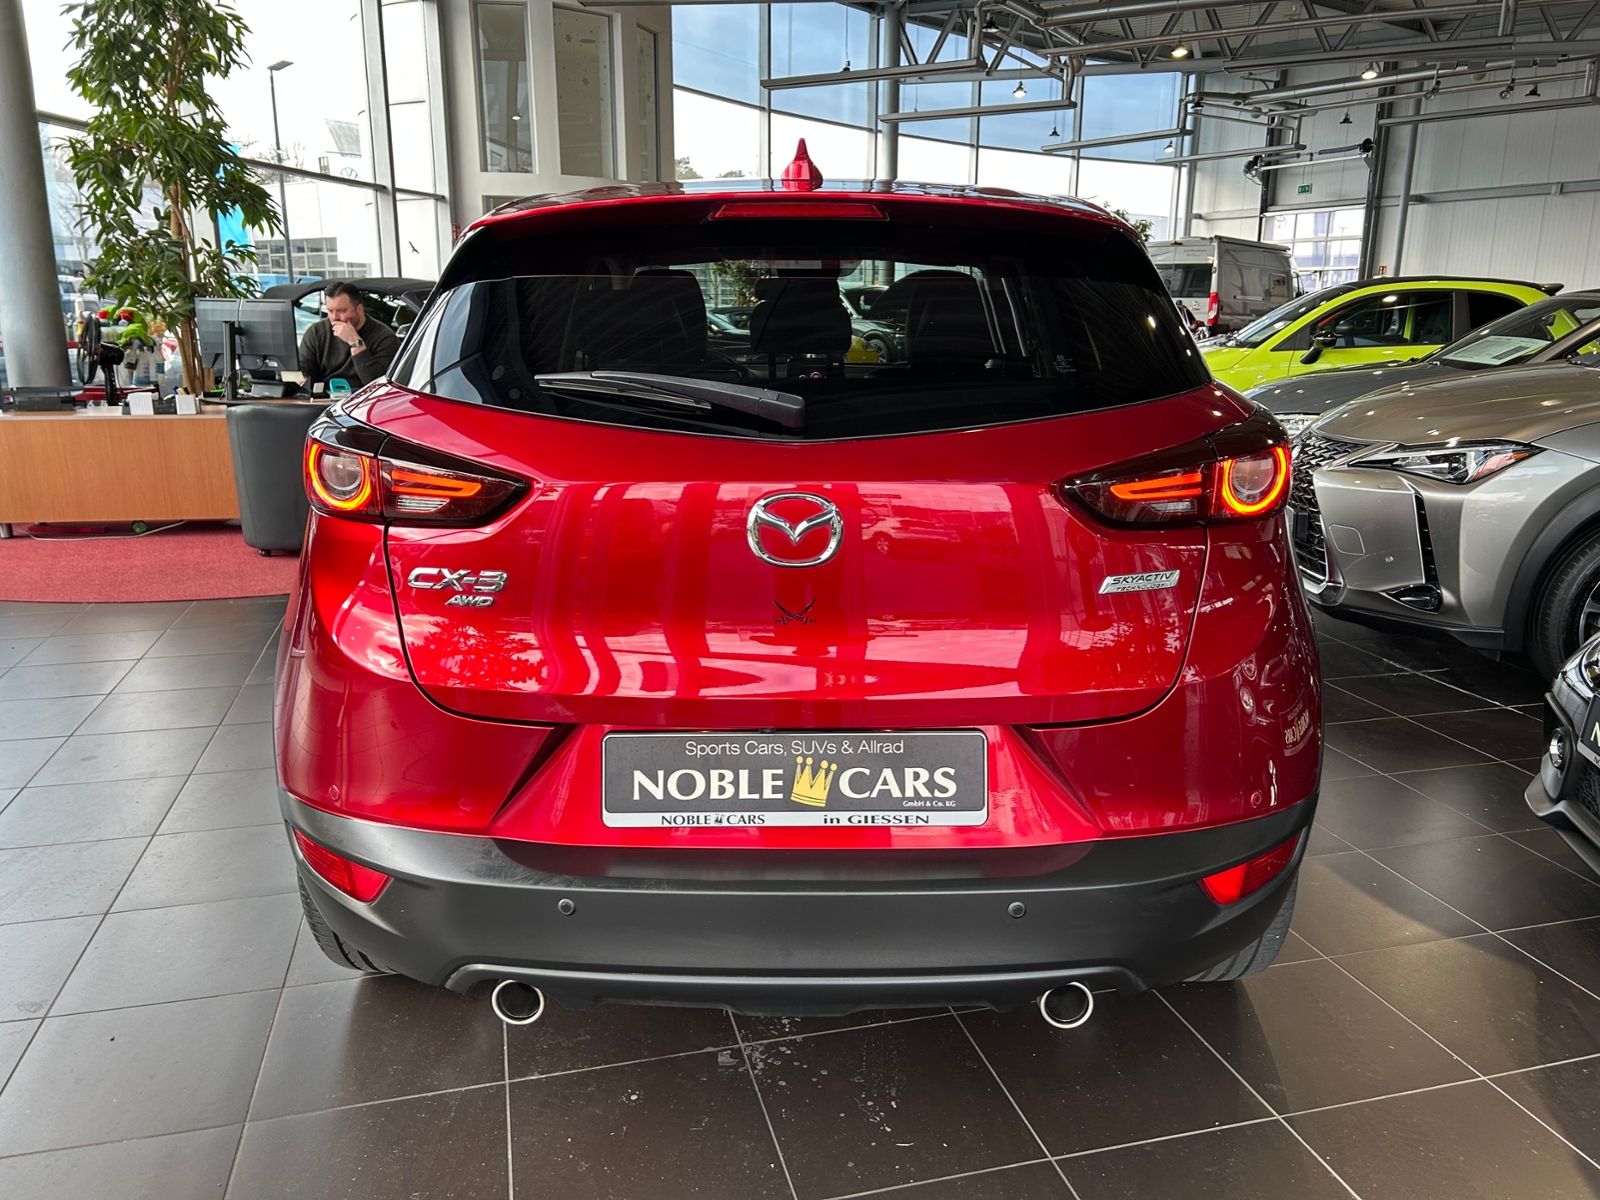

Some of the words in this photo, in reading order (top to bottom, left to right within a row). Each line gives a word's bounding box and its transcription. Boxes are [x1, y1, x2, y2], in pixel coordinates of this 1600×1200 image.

[407, 567, 508, 593] CX-3
[1112, 572, 1173, 584] SKYACTIV
[1116, 583, 1166, 591] TECHNOLOGY
[444, 594, 494, 607] AWD
[685, 741, 740, 758] Sports
[745, 740, 787, 757] Cars,
[790, 740, 837, 755] SUVs
[841, 740, 854, 754] &
[857, 740, 904, 754] Allrad
[633, 769, 784, 800] NOBLE
[838, 767, 957, 799] CARS
[661, 814, 712, 826] NOBLE
[726, 814, 766, 825] CARS
[823, 814, 841, 824] in
[847, 814, 930, 825] GIESSEN
